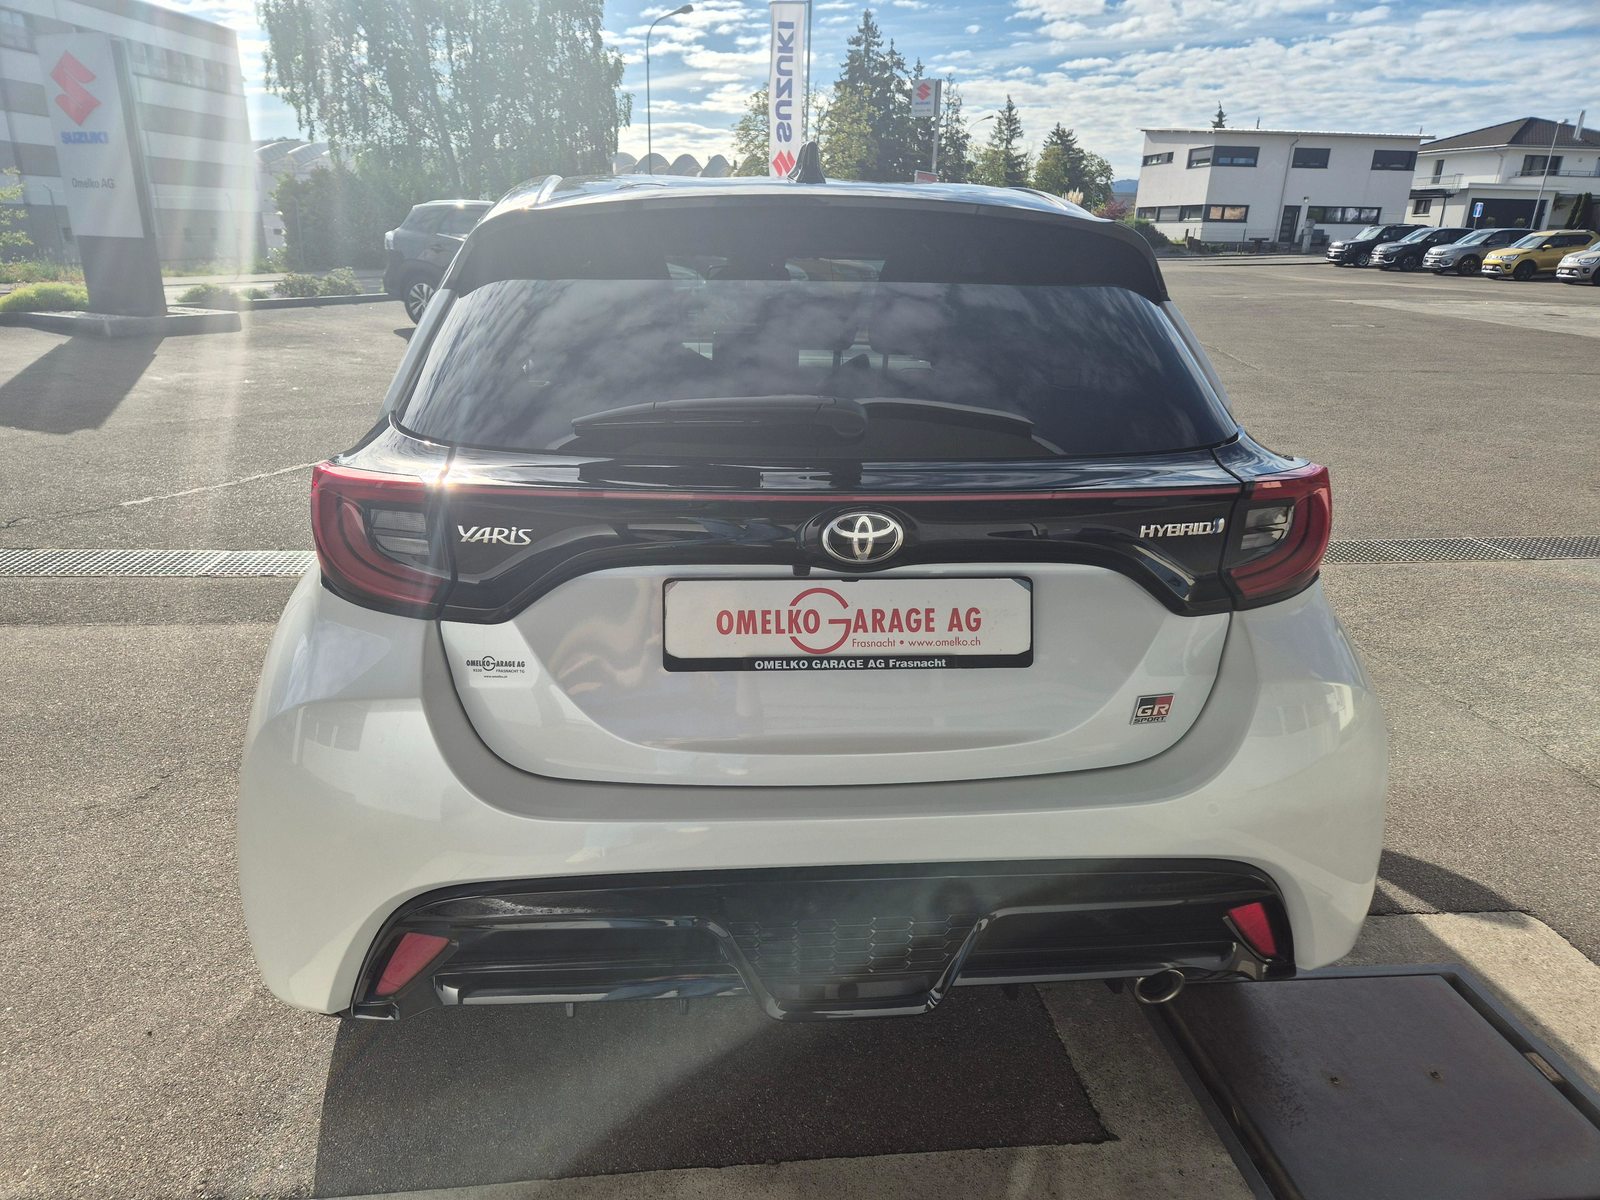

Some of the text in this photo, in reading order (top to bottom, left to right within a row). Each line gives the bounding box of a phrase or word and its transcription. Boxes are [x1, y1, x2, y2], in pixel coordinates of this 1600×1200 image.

[61, 131, 109, 144] SUZUKI
[101, 178, 114, 189] AG
[1139, 521, 1214, 538] HYBRID
[716, 588, 982, 654] OMELKO GARAGE AG
[852, 636, 981, 648] Frasnacht www.omelko.ch
[755, 658, 947, 669] OMELKO GARAGE AG Frasnacht
[1136, 704, 1170, 717] GR
[1133, 716, 1167, 724] SPORT
